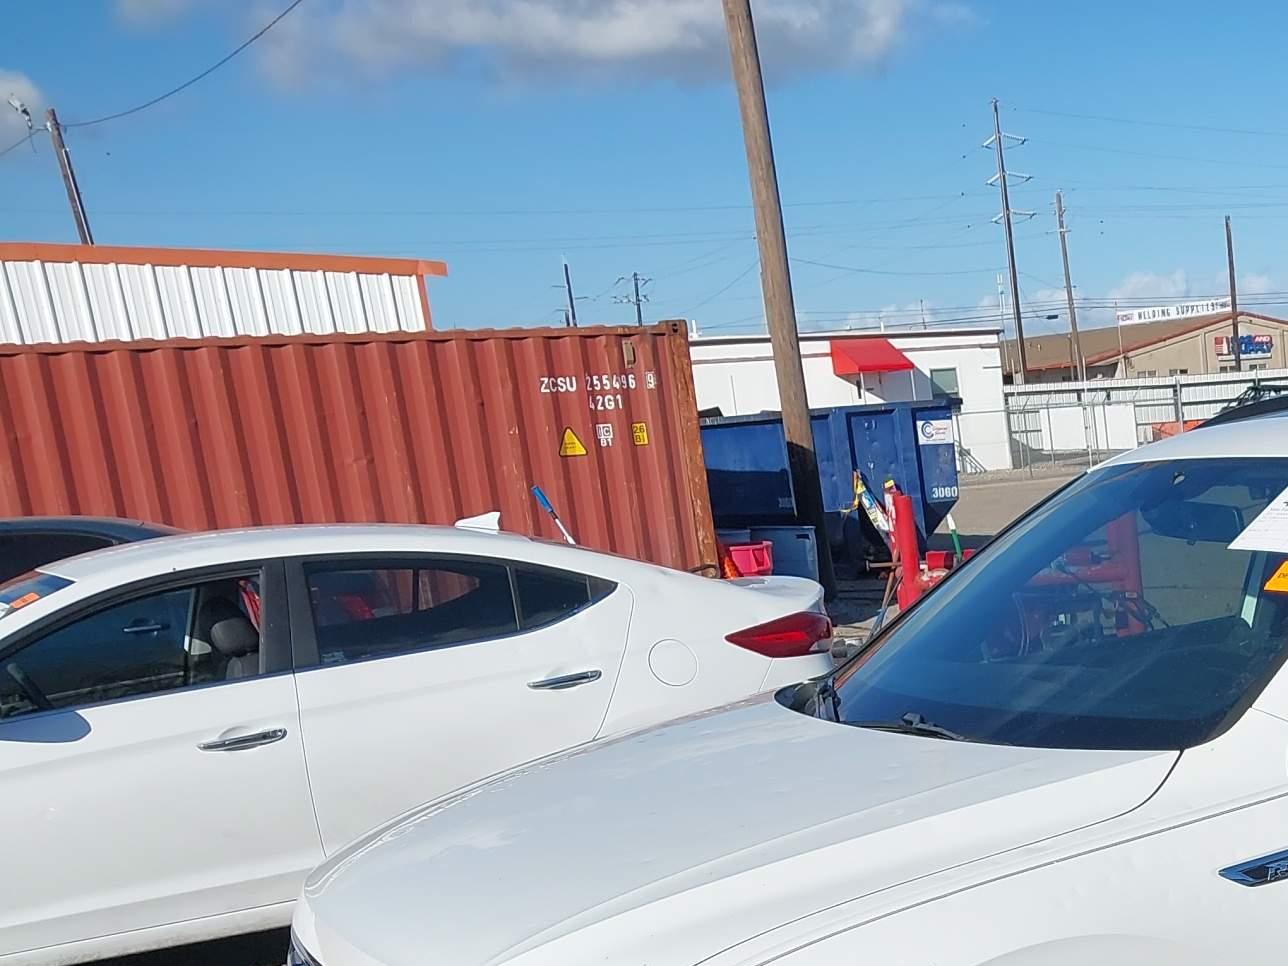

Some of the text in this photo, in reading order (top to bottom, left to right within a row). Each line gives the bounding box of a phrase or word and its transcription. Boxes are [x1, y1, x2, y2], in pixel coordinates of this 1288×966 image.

[1137, 307, 1170, 320] WELDING
[1254, 335, 1271, 343] AND
[540, 376, 577, 393] ZCSU
[586, 374, 636, 391] 255496
[589, 394, 623, 410] 42G1
